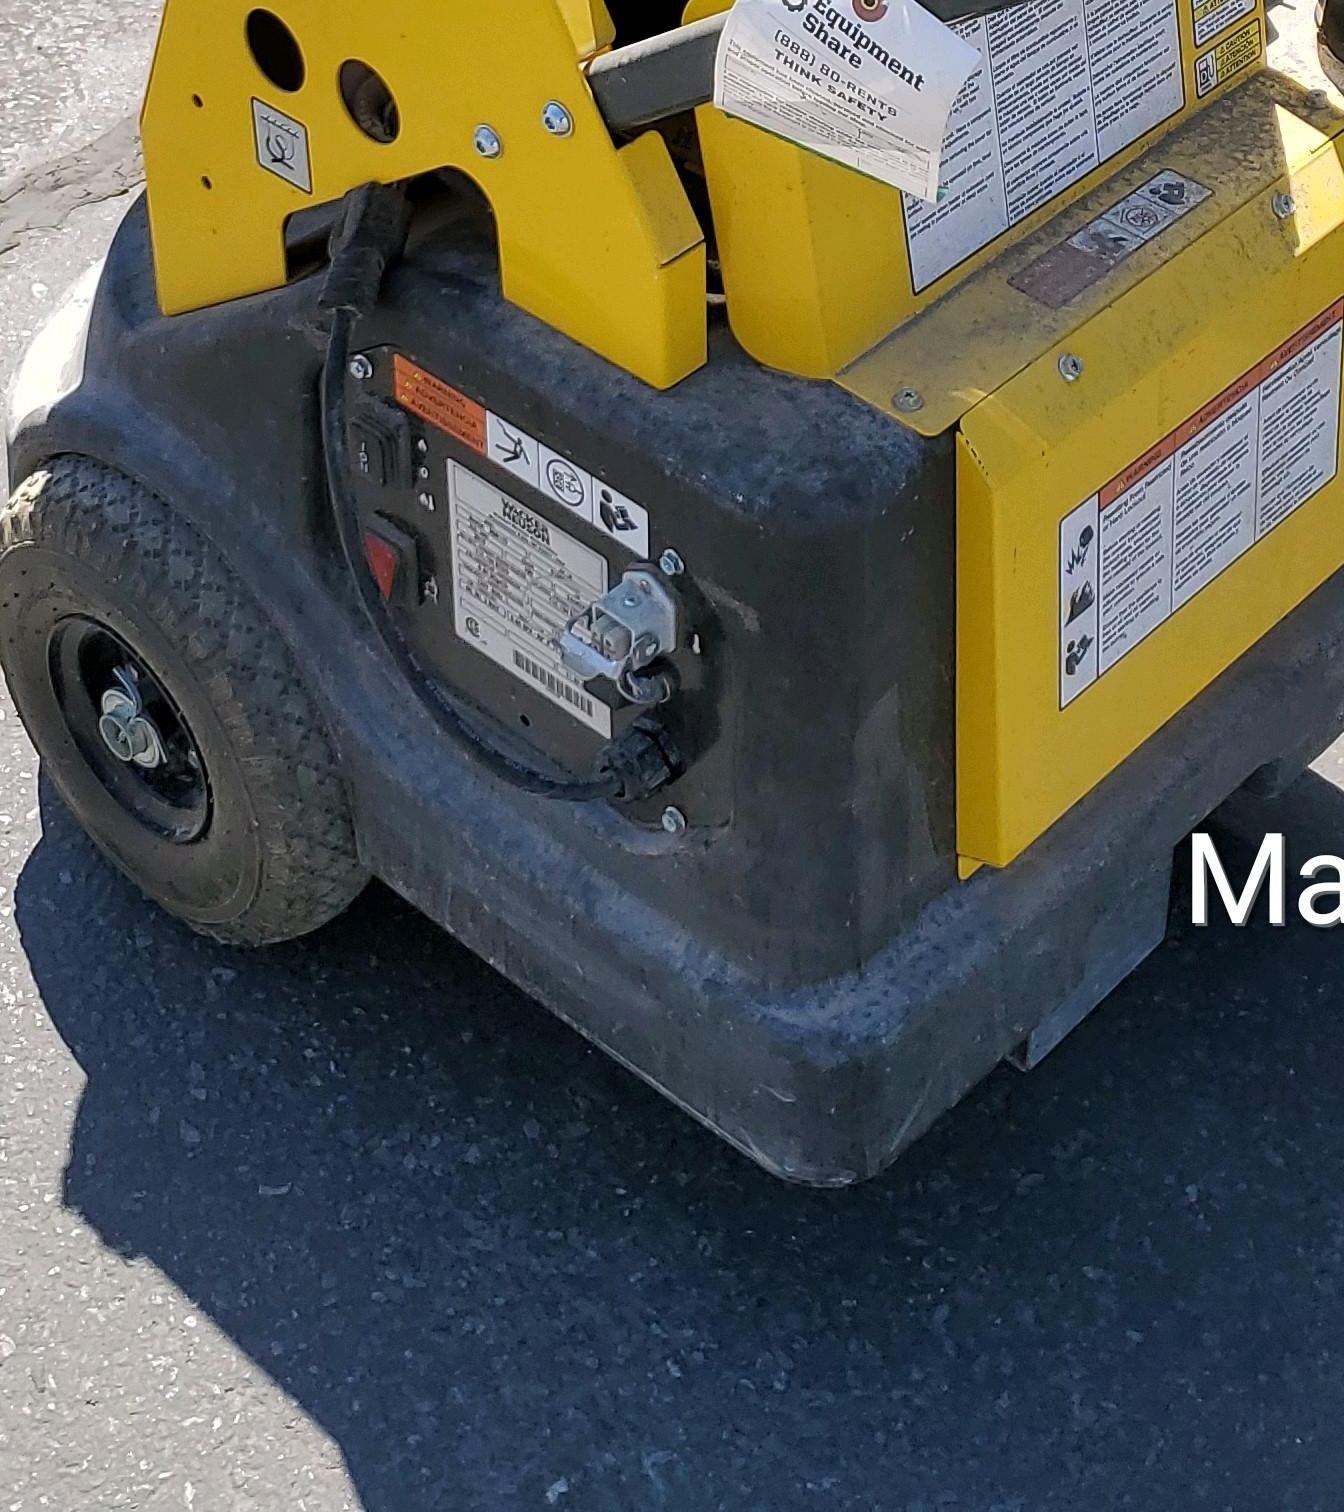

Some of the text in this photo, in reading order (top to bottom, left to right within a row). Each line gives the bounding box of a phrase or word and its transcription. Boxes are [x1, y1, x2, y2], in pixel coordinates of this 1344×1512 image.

[774, 29, 897, 117] (888) 80-RENTS
[802, 12, 862, 70] Share
[774, 49, 887, 122] THINK SAFETY
